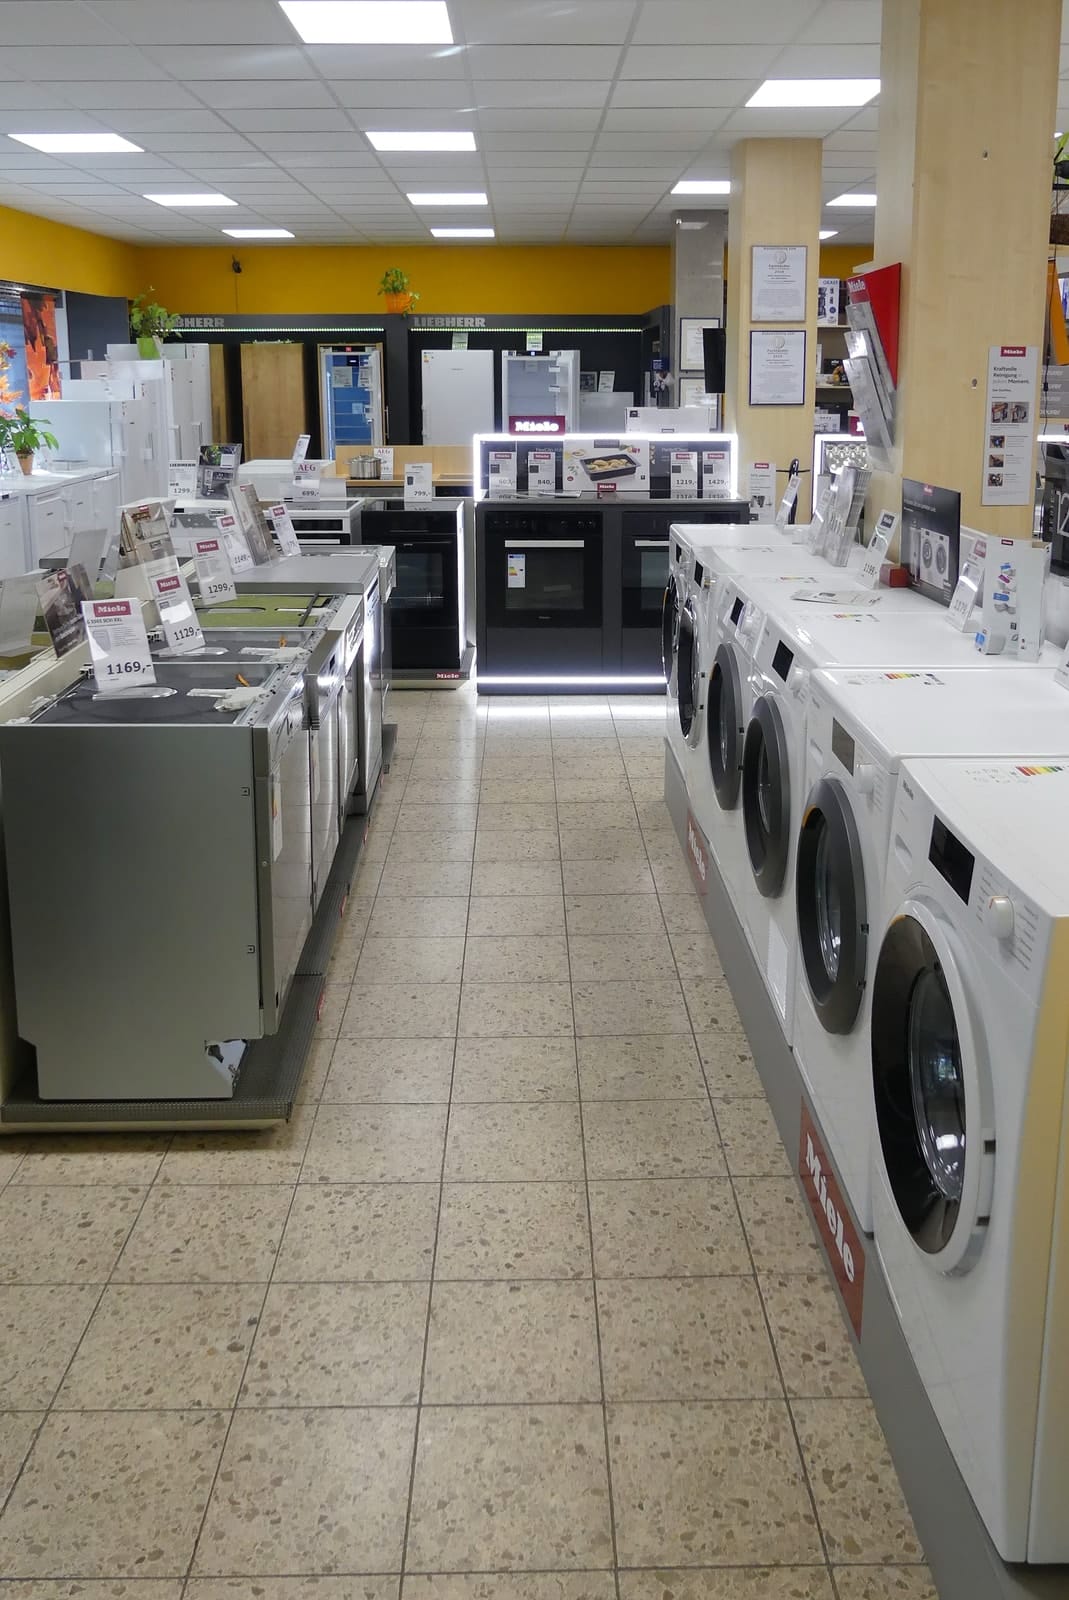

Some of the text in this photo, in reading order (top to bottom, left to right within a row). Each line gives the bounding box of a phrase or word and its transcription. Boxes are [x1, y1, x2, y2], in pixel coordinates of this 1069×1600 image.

[414, 317, 485, 328] LIEBHERR
[515, 421, 559, 432] Miele
[297, 464, 317, 472] AEG
[160, 580, 178, 588] Miele
[208, 582, 234, 594] 1299,-
[98, 604, 127, 613] Miele
[173, 626, 201, 641] 1129,-
[106, 661, 152, 675] 1169,-
[806, 1132, 854, 1283] Miele
